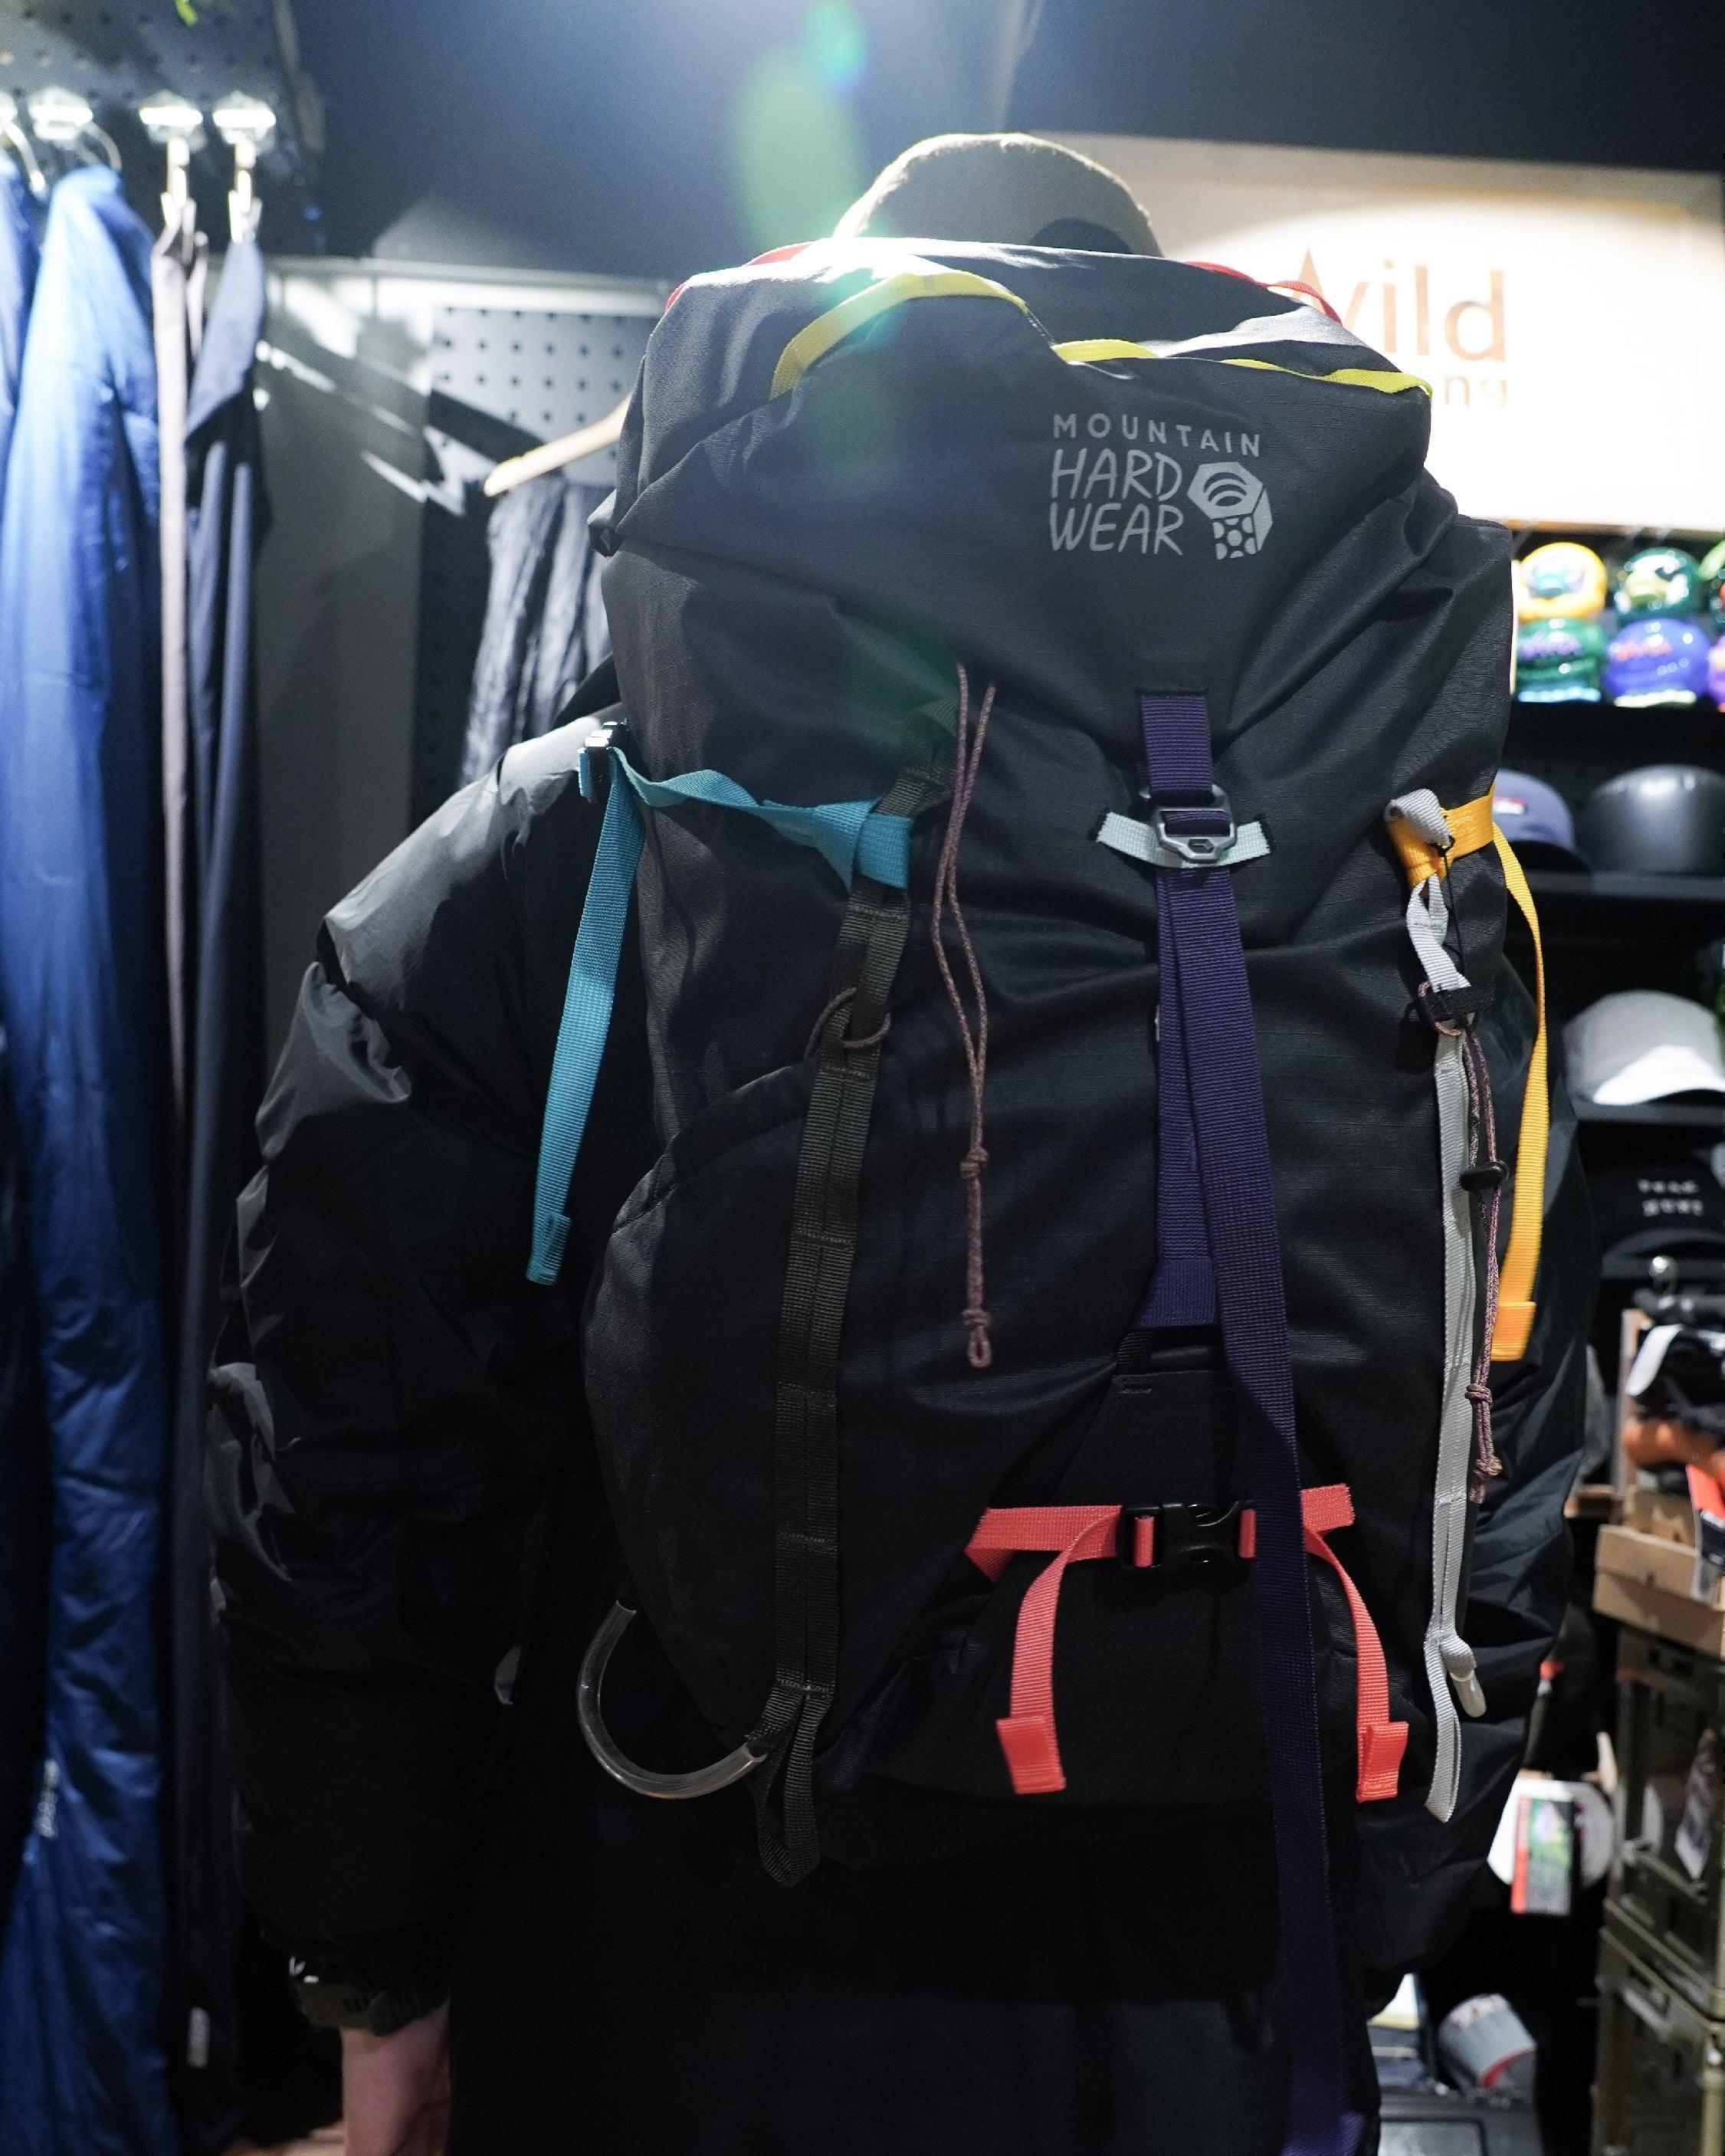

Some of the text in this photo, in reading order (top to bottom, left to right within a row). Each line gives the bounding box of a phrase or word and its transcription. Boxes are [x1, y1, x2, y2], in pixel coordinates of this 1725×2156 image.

[1053, 412, 1261, 458] MOUNTAIN
[1051, 448, 1183, 502] HARD
[1049, 501, 1184, 556] WEAR
